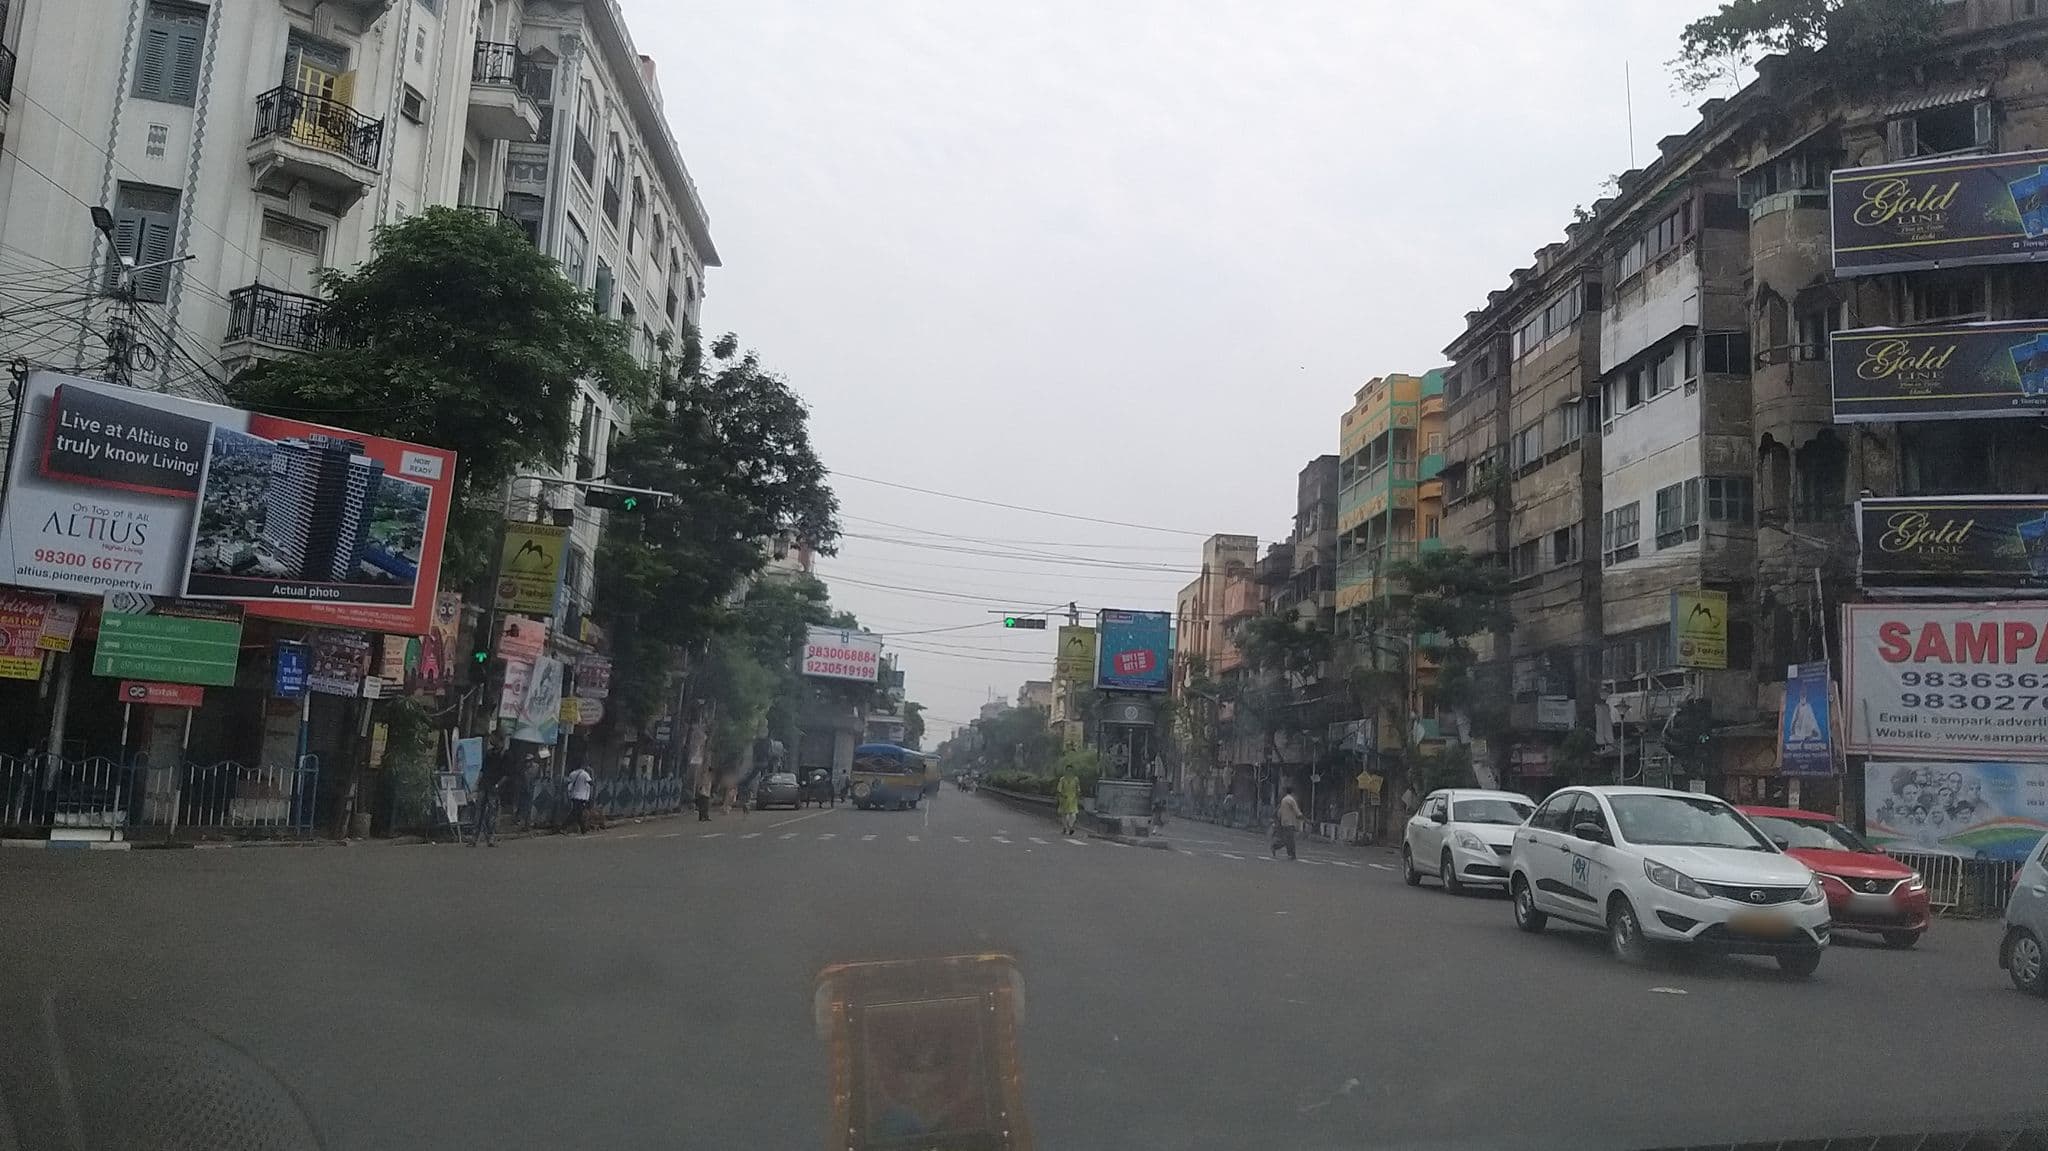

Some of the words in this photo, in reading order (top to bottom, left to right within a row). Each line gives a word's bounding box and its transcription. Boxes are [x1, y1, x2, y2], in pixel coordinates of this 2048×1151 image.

[1854, 178, 1960, 227] Gold
[1898, 213, 1949, 225] LINE
[1857, 339, 1957, 380] Gold
[1898, 371, 1945, 381] LINE
[61, 410, 101, 433] Live
[105, 424, 123, 438] at
[127, 426, 170, 450] Altius
[175, 437, 188, 452] to
[57, 434, 101, 460] truly
[105, 443, 149, 465] know
[153, 454, 199, 477] Living!
[73, 503, 88, 512] On
[92, 505, 109, 517] Top
[113, 510, 125, 518] of
[42, 511, 148, 546] ALTIUS
[1879, 510, 1975, 552] Gold
[34, 548, 86, 567] 98300
[92, 556, 143, 574] 66777
[17, 565, 153, 591] altius.pioneerproperty.in
[272, 584, 307, 596] Actual
[309, 586, 341, 598] photo
[808, 645, 876, 663] 9830068884
[807, 660, 875, 678] 9230519199
[1879, 712, 1917, 723] Email
[1876, 727, 1931, 739] Website
